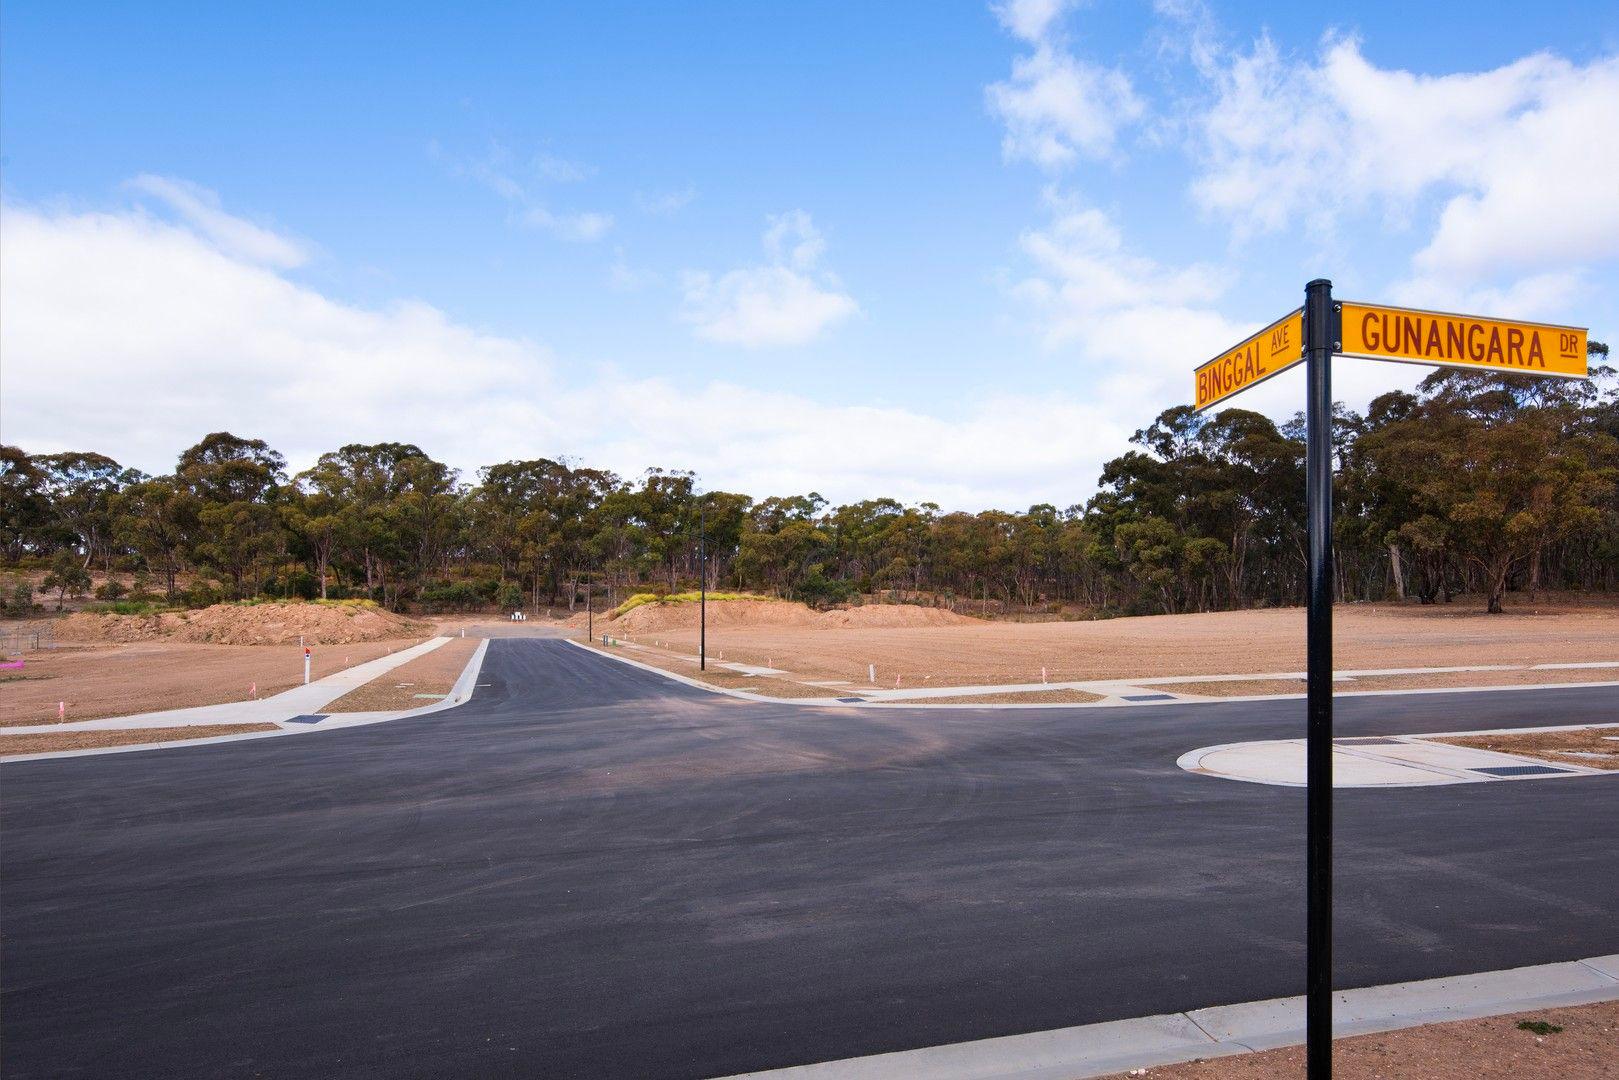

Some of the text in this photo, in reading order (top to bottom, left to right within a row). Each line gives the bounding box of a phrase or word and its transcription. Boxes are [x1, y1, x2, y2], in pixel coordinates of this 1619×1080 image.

[1199, 324, 1290, 405] BINGGAL AVE
[1361, 312, 1578, 368] GUNANGARA DR
